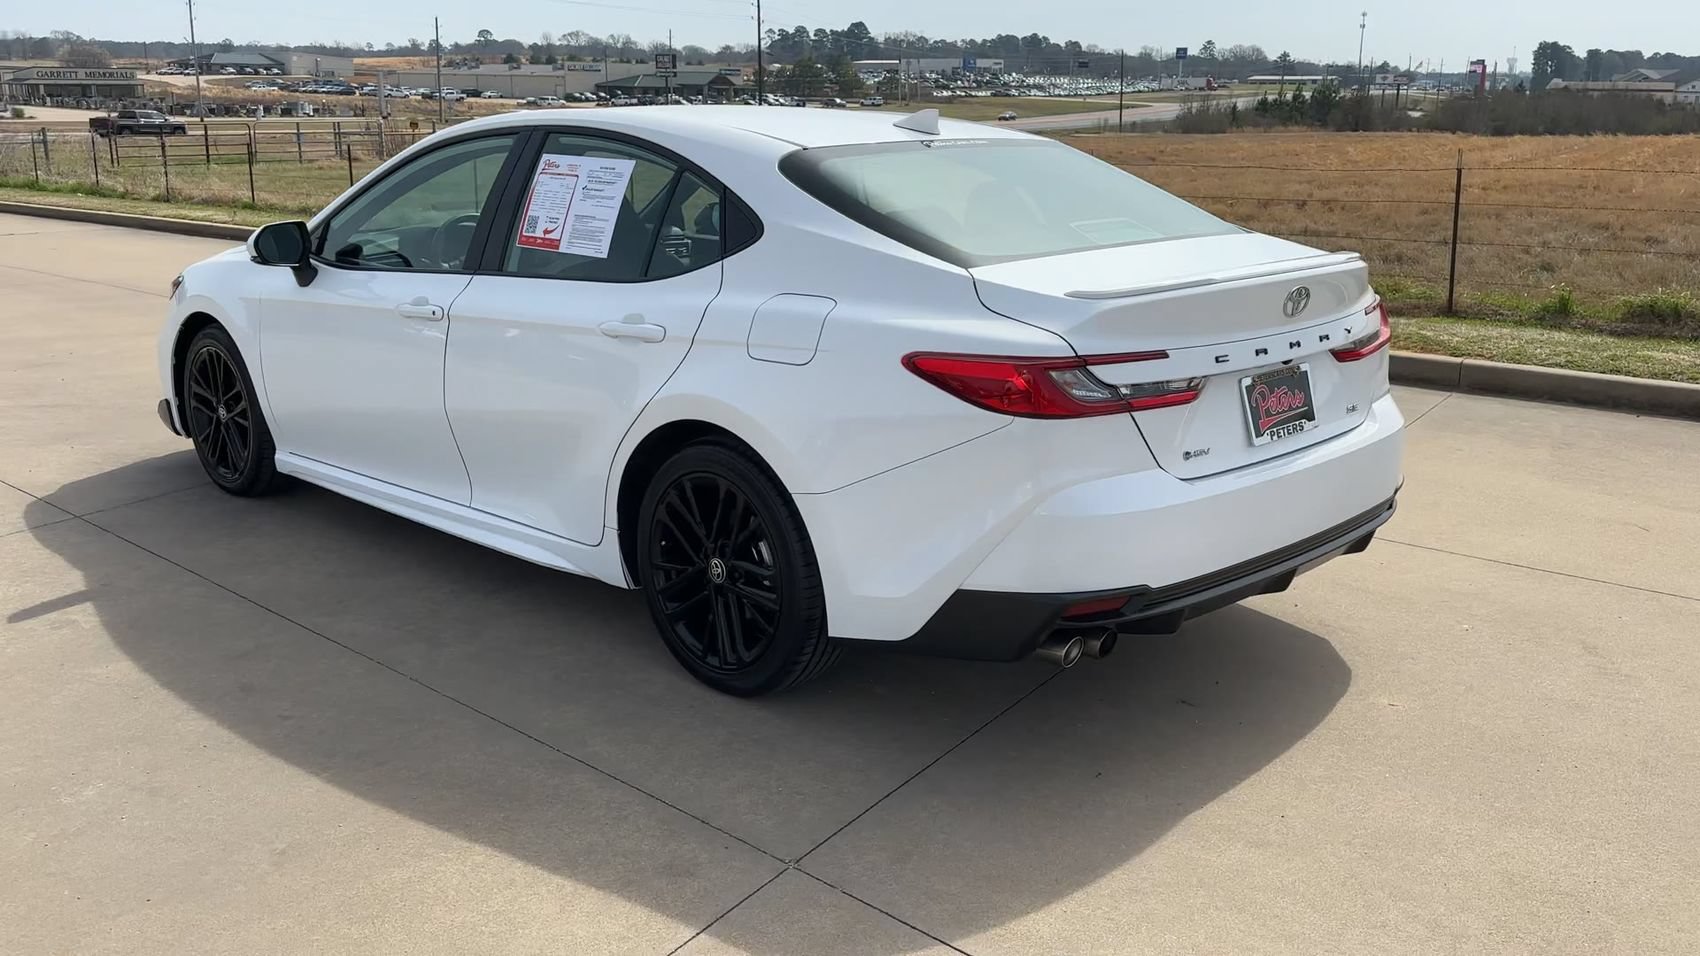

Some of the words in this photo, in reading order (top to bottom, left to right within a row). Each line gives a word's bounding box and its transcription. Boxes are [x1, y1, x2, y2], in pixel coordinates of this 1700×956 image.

[36, 70, 78, 79] GARRETT
[85, 71, 135, 79] MEMORIALS
[1214, 326, 1353, 364] CAMRY
[1251, 384, 1305, 421] Peters
